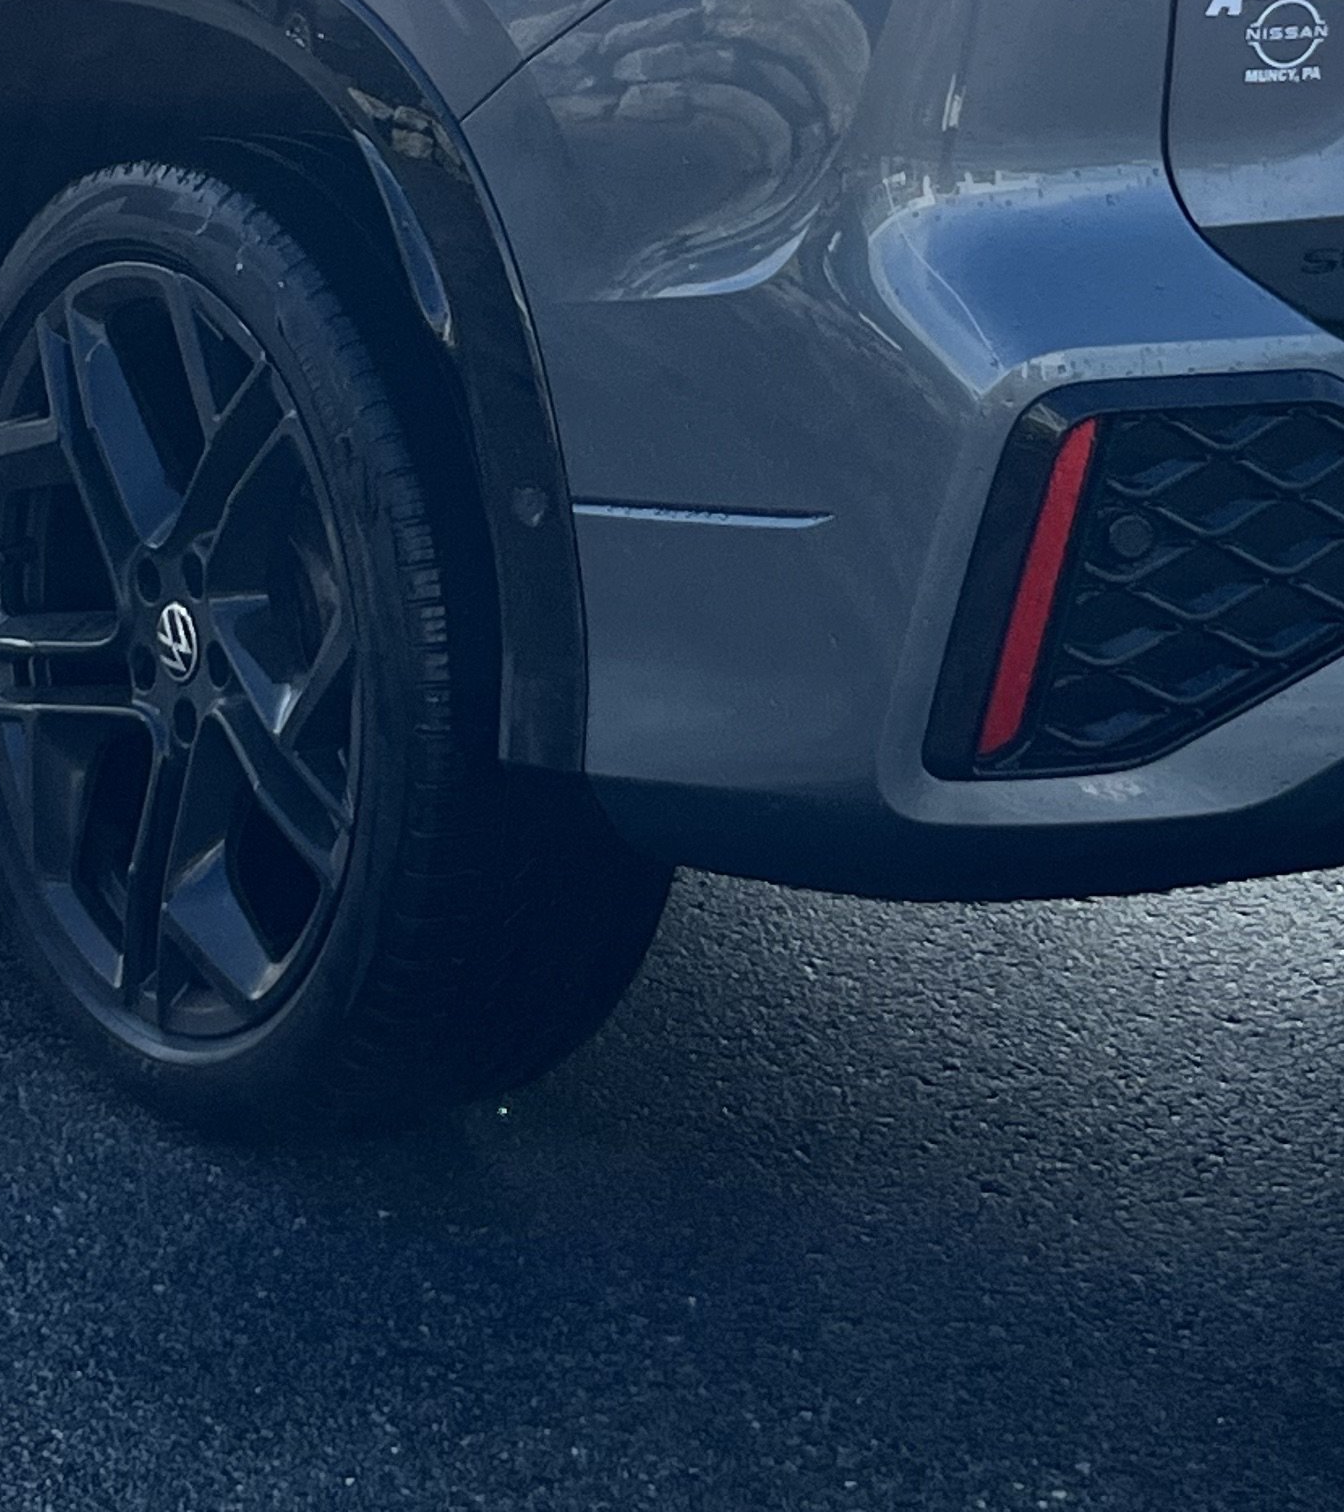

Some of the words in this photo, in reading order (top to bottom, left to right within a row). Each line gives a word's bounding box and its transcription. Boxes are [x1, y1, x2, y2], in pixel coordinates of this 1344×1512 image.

[1245, 24, 1329, 40] NISSAN
[1244, 66, 1300, 83] MUNCY,
[1302, 66, 1321, 81] PA
